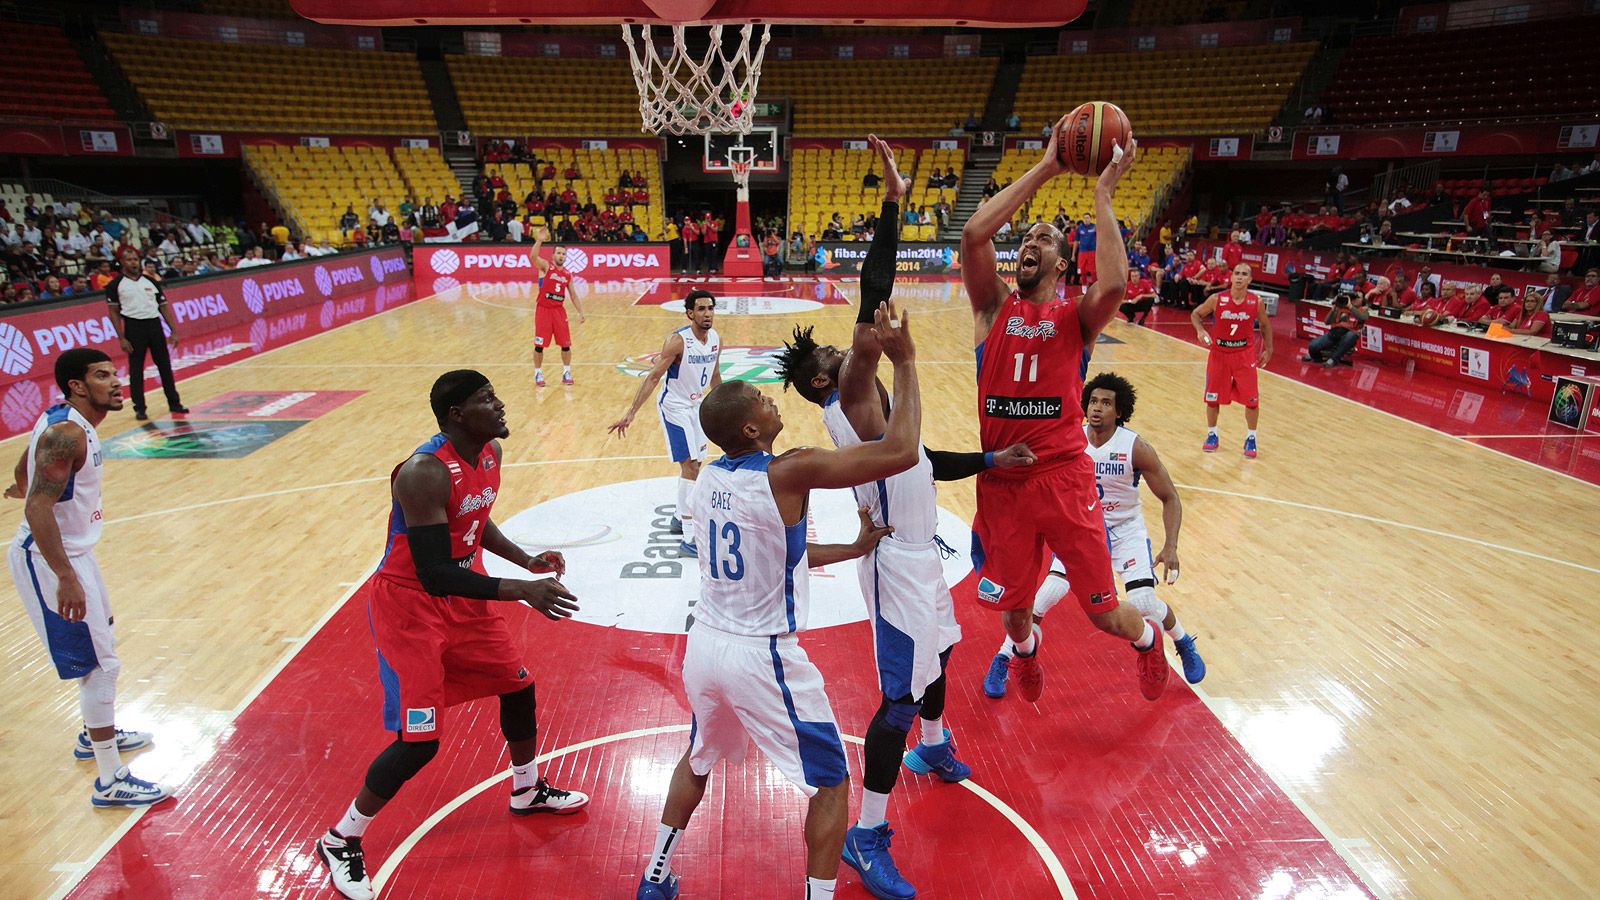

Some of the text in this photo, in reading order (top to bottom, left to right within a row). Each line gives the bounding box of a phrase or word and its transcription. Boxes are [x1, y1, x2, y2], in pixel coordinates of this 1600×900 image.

[1076, 113, 1089, 161] molten
[381, 257, 406, 274] PDVSA
[464, 253, 532, 268] PDVSA
[593, 253, 659, 268] PDVSA
[331, 266, 364, 287] PDVSA
[262, 277, 305, 302] PDVSA
[555, 283, 561, 292] 5
[172, 293, 229, 324] PDVSA
[33, 316, 119, 355] PDVSA
[1230, 324, 1239, 336] 7
[700, 366, 708, 387] 6
[1013, 353, 1039, 382] 11
[1094, 462, 1124, 475] ICANA
[711, 491, 732, 510] BAEZ
[462, 520, 479, 546] 4
[619, 504, 684, 579] Banco
[709, 519, 745, 581] 13
